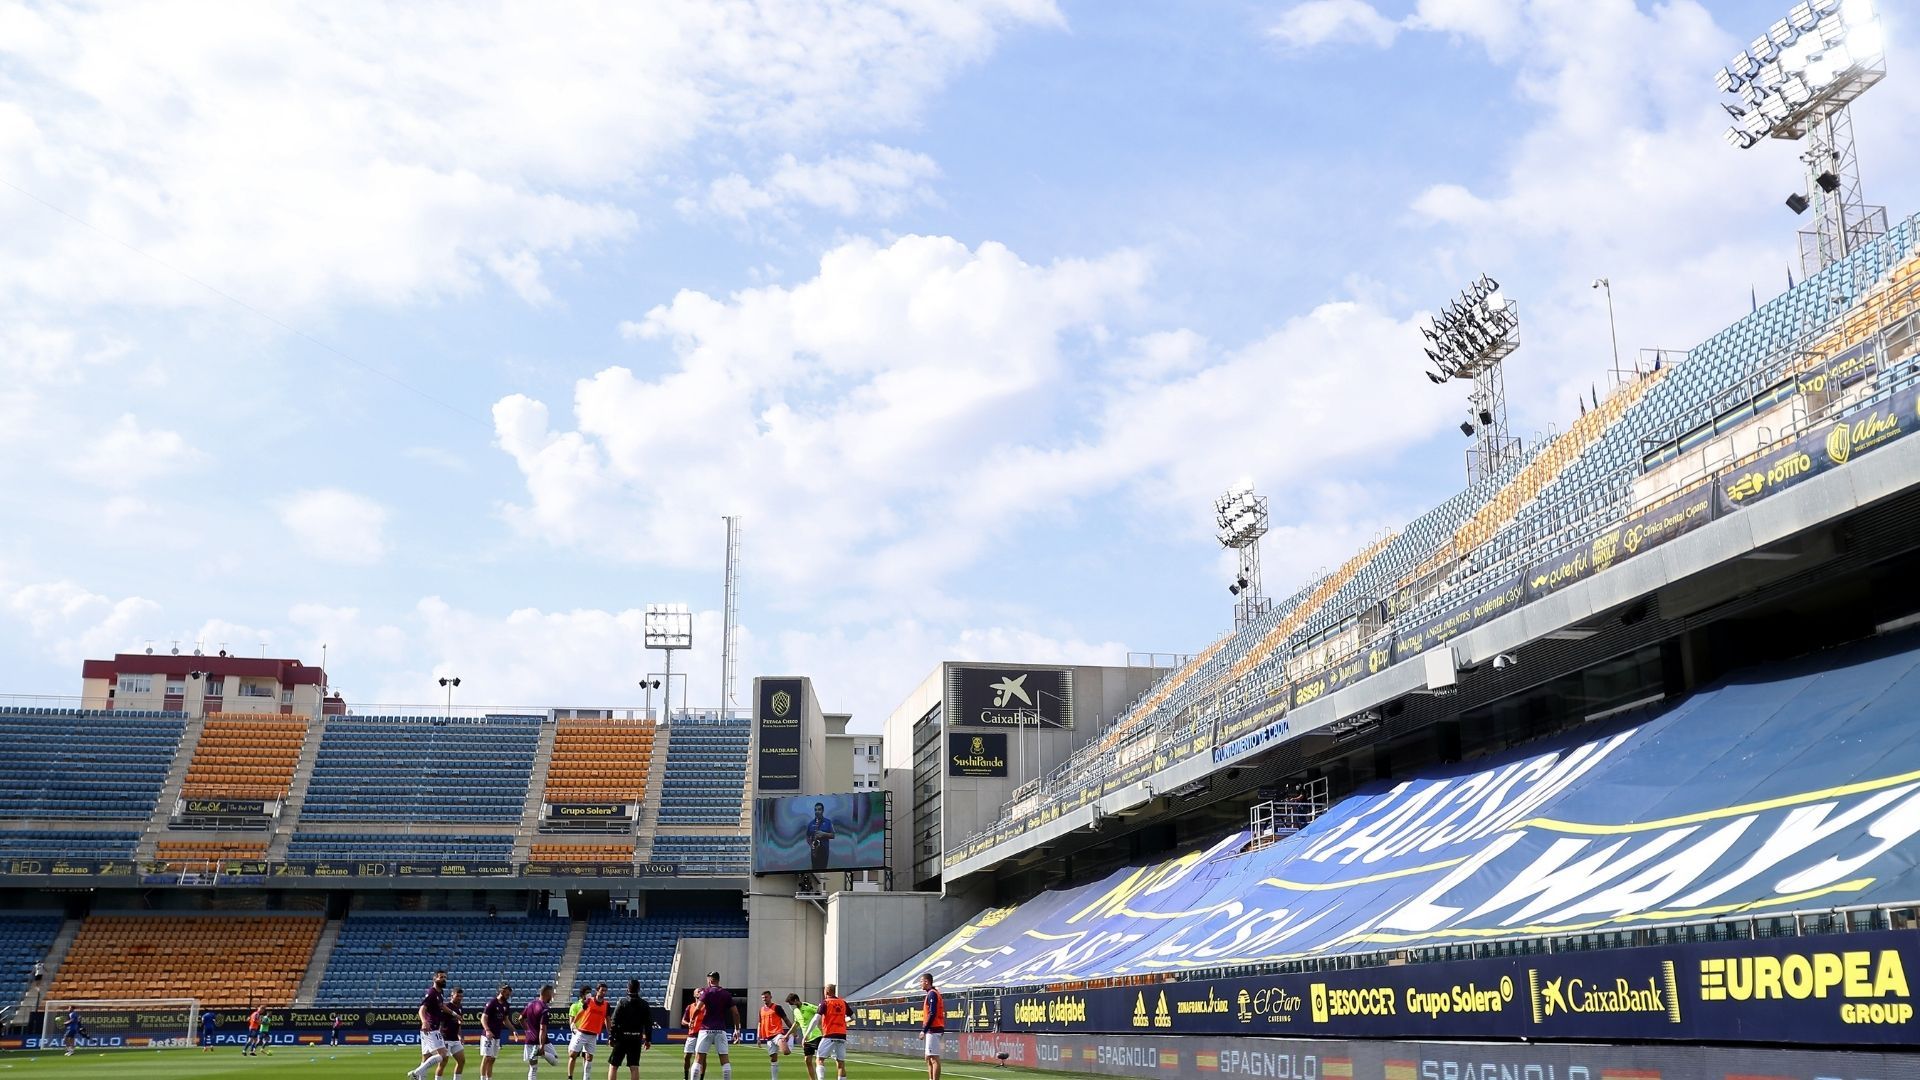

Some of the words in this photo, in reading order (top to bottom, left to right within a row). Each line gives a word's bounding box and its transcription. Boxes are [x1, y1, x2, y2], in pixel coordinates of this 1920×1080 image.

[1767, 454, 1811, 487] POTITO
[1663, 511, 1685, 527] Dental
[980, 711, 1041, 725] CaixaBank
[953, 754, 1004, 767] SushiPanda
[560, 807, 585, 816] Grupo
[586, 806, 612, 814] Solera
[644, 864, 674, 873] VOGO
[1700, 950, 1911, 1001] EUROPEA
[1271, 987, 1302, 1014] Faro
[1328, 987, 1396, 1016] BESOCCER
[1406, 987, 1451, 1020] Grupo
[1452, 982, 1502, 1013] Solera
[1567, 977, 1666, 1014] CaixaBank
[290, 1013, 326, 1022] PETACA
[1267, 1014, 1292, 1023] CATERING
[1840, 1003, 1913, 1024] GROUP
[1098, 1045, 1157, 1068] SPAGNOLO
[1220, 1050, 1316, 1080] SPAGNOLO
